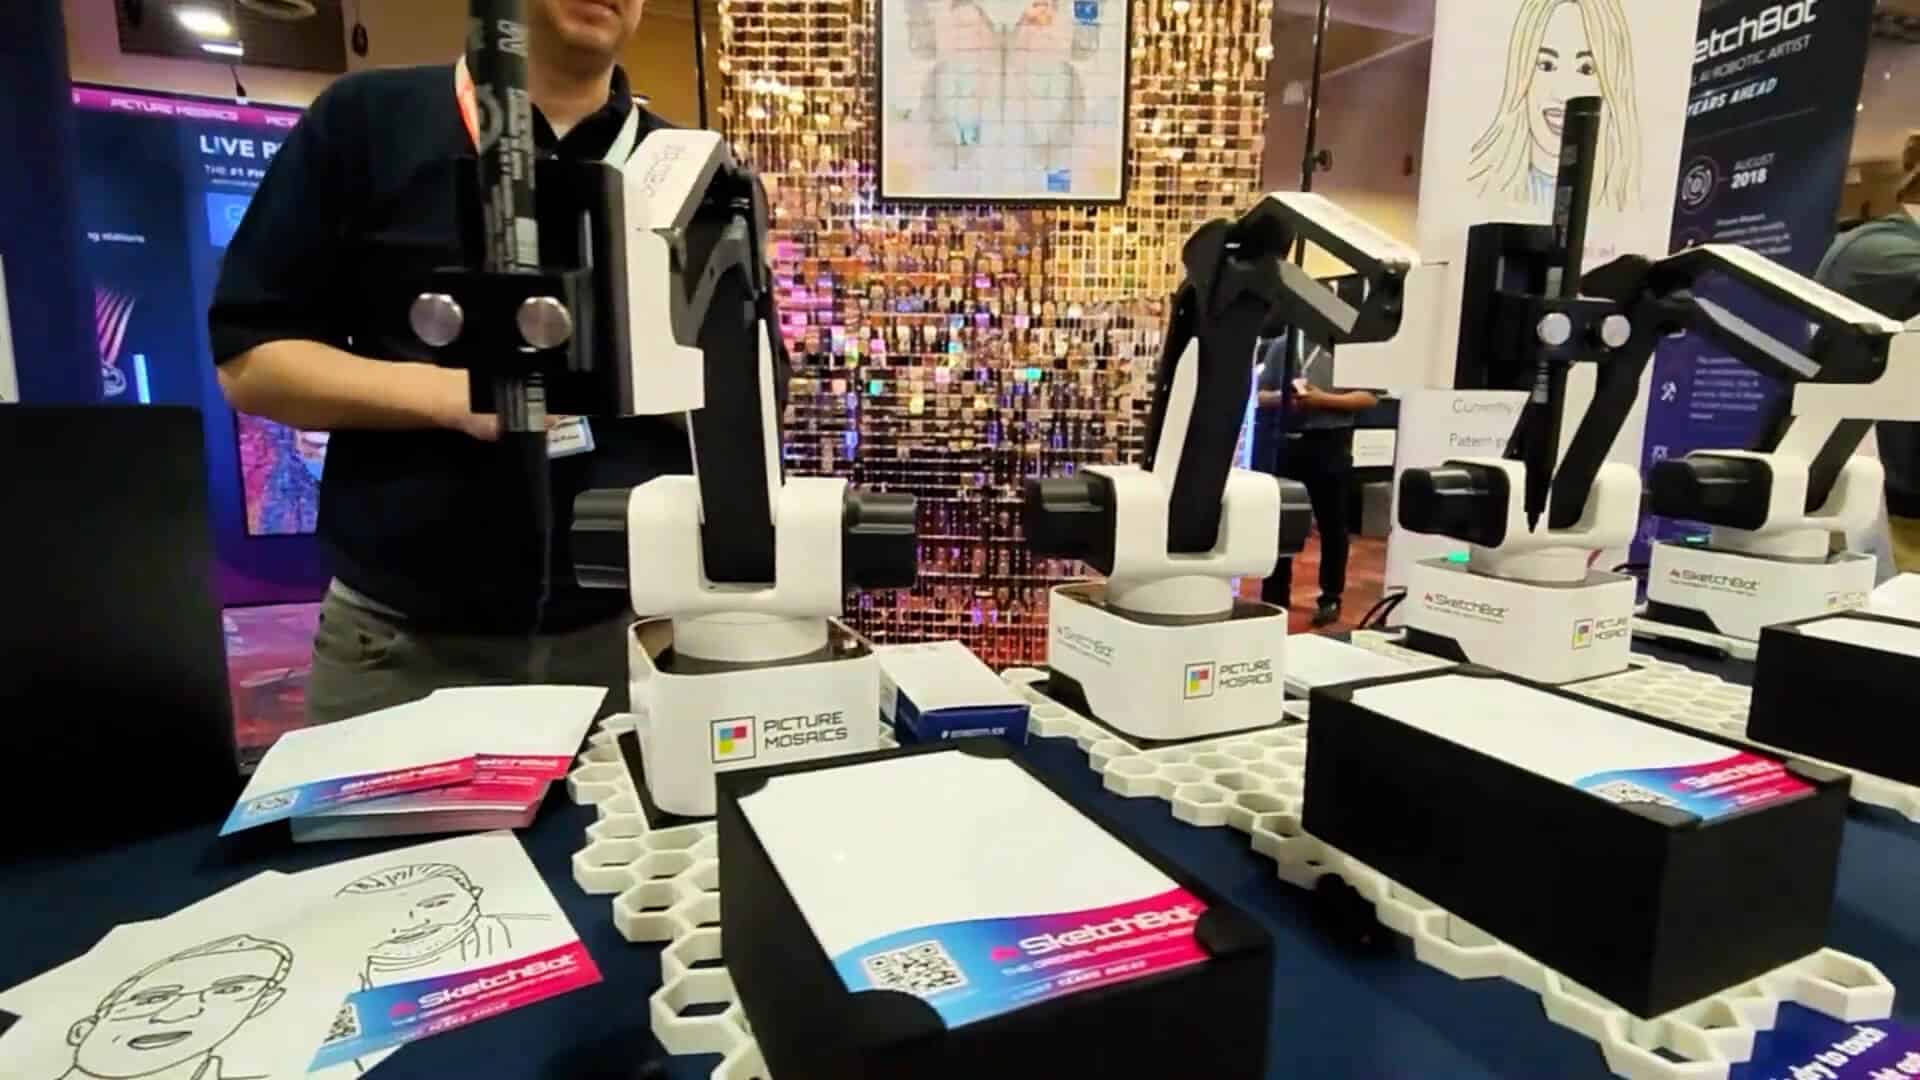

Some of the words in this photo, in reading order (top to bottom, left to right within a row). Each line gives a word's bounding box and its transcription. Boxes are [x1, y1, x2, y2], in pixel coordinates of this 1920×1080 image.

[1767, 34, 1812, 59] ARTIST
[1729, 76, 1778, 104] AHEAD
[199, 133, 256, 158] LIVE
[1730, 167, 1768, 189] 2018
[1218, 658, 1272, 675] PICTURE
[1218, 672, 1273, 690] MOSAICS
[763, 711, 844, 733] PICTURE
[763, 727, 848, 750] MOSAICS
[1018, 906, 1199, 956] SketchBot
[417, 953, 577, 1010] SketchBot
[1831, 1024, 1889, 1056] touch
